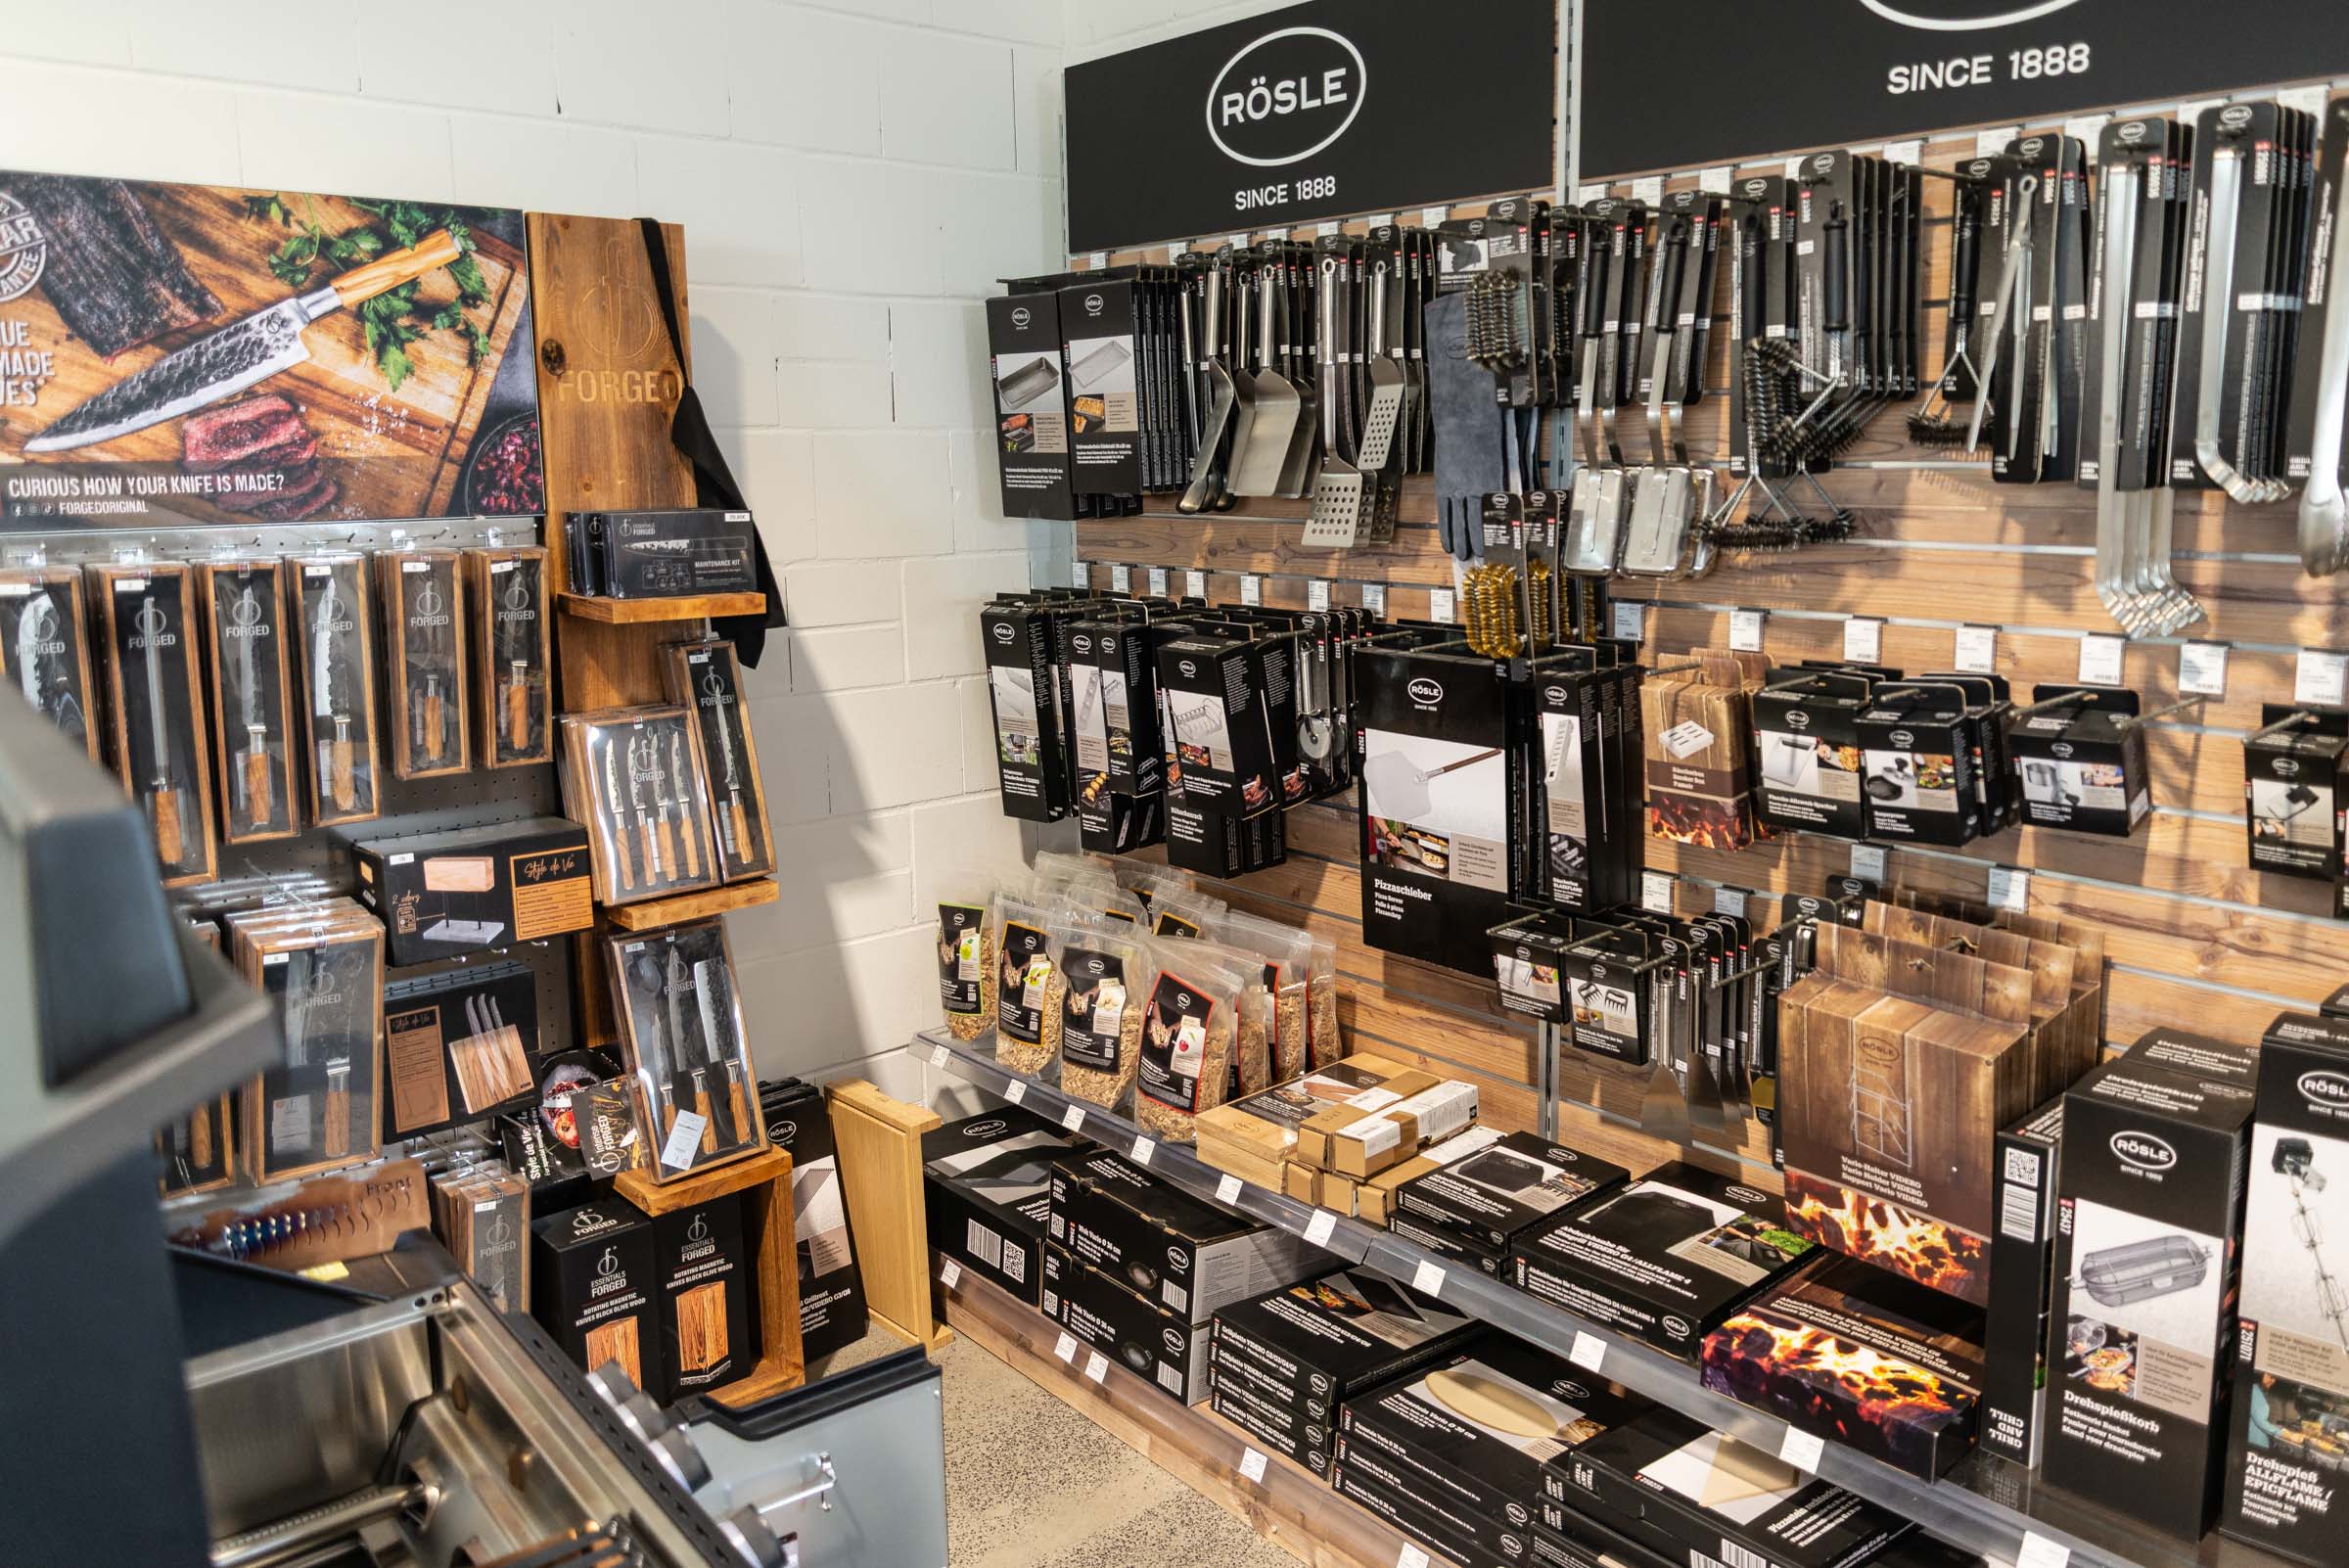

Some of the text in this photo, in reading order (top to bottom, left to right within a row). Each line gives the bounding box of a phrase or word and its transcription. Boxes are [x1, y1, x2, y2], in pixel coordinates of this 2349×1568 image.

[1887, 42, 2091, 94] SINCE 1888
[1222, 68, 1347, 126] RÖSLE
[1234, 175, 1336, 211] SINCE 1888
[559, 370, 684, 403] FORGED
[8, 474, 285, 498] CURIOUS HOW YOUR KNIFE IS MADE?
[60, 499, 149, 516] FORGEDORIGINAL
[410, 615, 448, 627] FORGED
[498, 610, 534, 622] FORGED
[128, 634, 175, 649] FORGED
[226, 624, 269, 637] FORGED
[1411, 685, 1440, 697] RÖSLE
[524, 854, 576, 881] Style de Vie
[1374, 878, 1432, 900] Pizzaschieber
[664, 981, 696, 994] FORGED
[1862, 1040, 1896, 1058] RÖSLE
[2304, 1079, 2349, 1098] RÖSL
[2308, 1103, 2332, 1115] SINCE
[598, 1115, 616, 1150] FORGED
[769, 1124, 794, 1138] RÖSLE
[968, 1122, 1001, 1133] RÖSLE
[522, 1130, 541, 1179] Style de Vie
[2116, 1139, 2170, 1162] RÖSLE
[1841, 1155, 1921, 1189] Vario-Halter VIDERO
[1841, 1164, 1923, 1197] Vario Holder VIDERO
[2120, 1164, 2143, 1177] SINCE
[1729, 1186, 1764, 1201] RÖSLE
[1842, 1172, 1928, 1208] Support Vario VIDERO
[575, 1219, 618, 1236] FORGED
[2060, 1207, 2073, 1234] 25437
[681, 1237, 714, 1253] ESSENTIALS
[1079, 1224, 1088, 1235] Wok
[1089, 1230, 1101, 1243] Vario
[1554, 1229, 1620, 1257] Gasgrill VIDERO
[1560, 1225, 1616, 1248] Abdeckhaube
[480, 1241, 516, 1259] FORGED
[682, 1244, 715, 1263] FORGED
[1170, 1249, 1186, 1264] RÖSLE
[591, 1270, 626, 1288] ESSENTIALS
[667, 1263, 733, 1290] KNIVES BLOCK OLIVE WOOD
[674, 1258, 725, 1279] ROTATING MAGNETIC
[591, 1279, 626, 1298] FORGED
[1591, 1291, 1611, 1306] VIDERO
[576, 1297, 646, 1327] KNIVES BLOCK OLIVE WOOD
[583, 1292, 636, 1316] ROTATING MAGNETIC
[1073, 1302, 1082, 1314] Wok
[1083, 1309, 1095, 1321] Vario
[1775, 1300, 1935, 1360] Protective Cover for BBQ-Station VIDERO
[1779, 1297, 1927, 1352] Abdeckhaube BBQ-Station VIDERO
[1166, 1332, 1182, 1346] RÖSLE
[1222, 1325, 1265, 1355] Grillplatte VIDERO
[1771, 1303, 1798, 1314] Housse
[1809, 1314, 1850, 1335] protection
[1851, 1330, 1870, 1342] pour
[1870, 1337, 1920, 1360] BBQ-Station
[1921, 1358, 1957, 1375] VIDERO
[2239, 1330, 2254, 1360] 251071
[1220, 1349, 1243, 1368] Grillplatte
[1244, 1362, 1263, 1379] VIDERO
[1218, 1374, 1260, 1404] Grillplatte VIDERO
[1222, 1400, 1265, 1429] Grillplatte VIDERO
[1394, 1394, 1477, 1440] Pizzastein Vario cm
[1990, 1407, 2024, 1429] CHILL
[2063, 1407, 2130, 1437] Rotisserie Basket
[2064, 1390, 2160, 1433] Drehspießkorb
[1988, 1429, 2023, 1450] GRILL
[1998, 1422, 2024, 1438] AND
[2061, 1425, 2103, 1446] Mand voor
[2062, 1415, 2162, 1458] Panier pour tournebroche
[2247, 1452, 2318, 1483] Drehspieß
[2244, 1475, 2328, 1511] EPICFLAME
[2245, 1465, 2333, 1499] ALLFLAME /
[2243, 1490, 2282, 1508] Rotisserie
[1767, 1508, 1808, 1534] Pizzastein
[2242, 1499, 2297, 1523] Tournebroche
